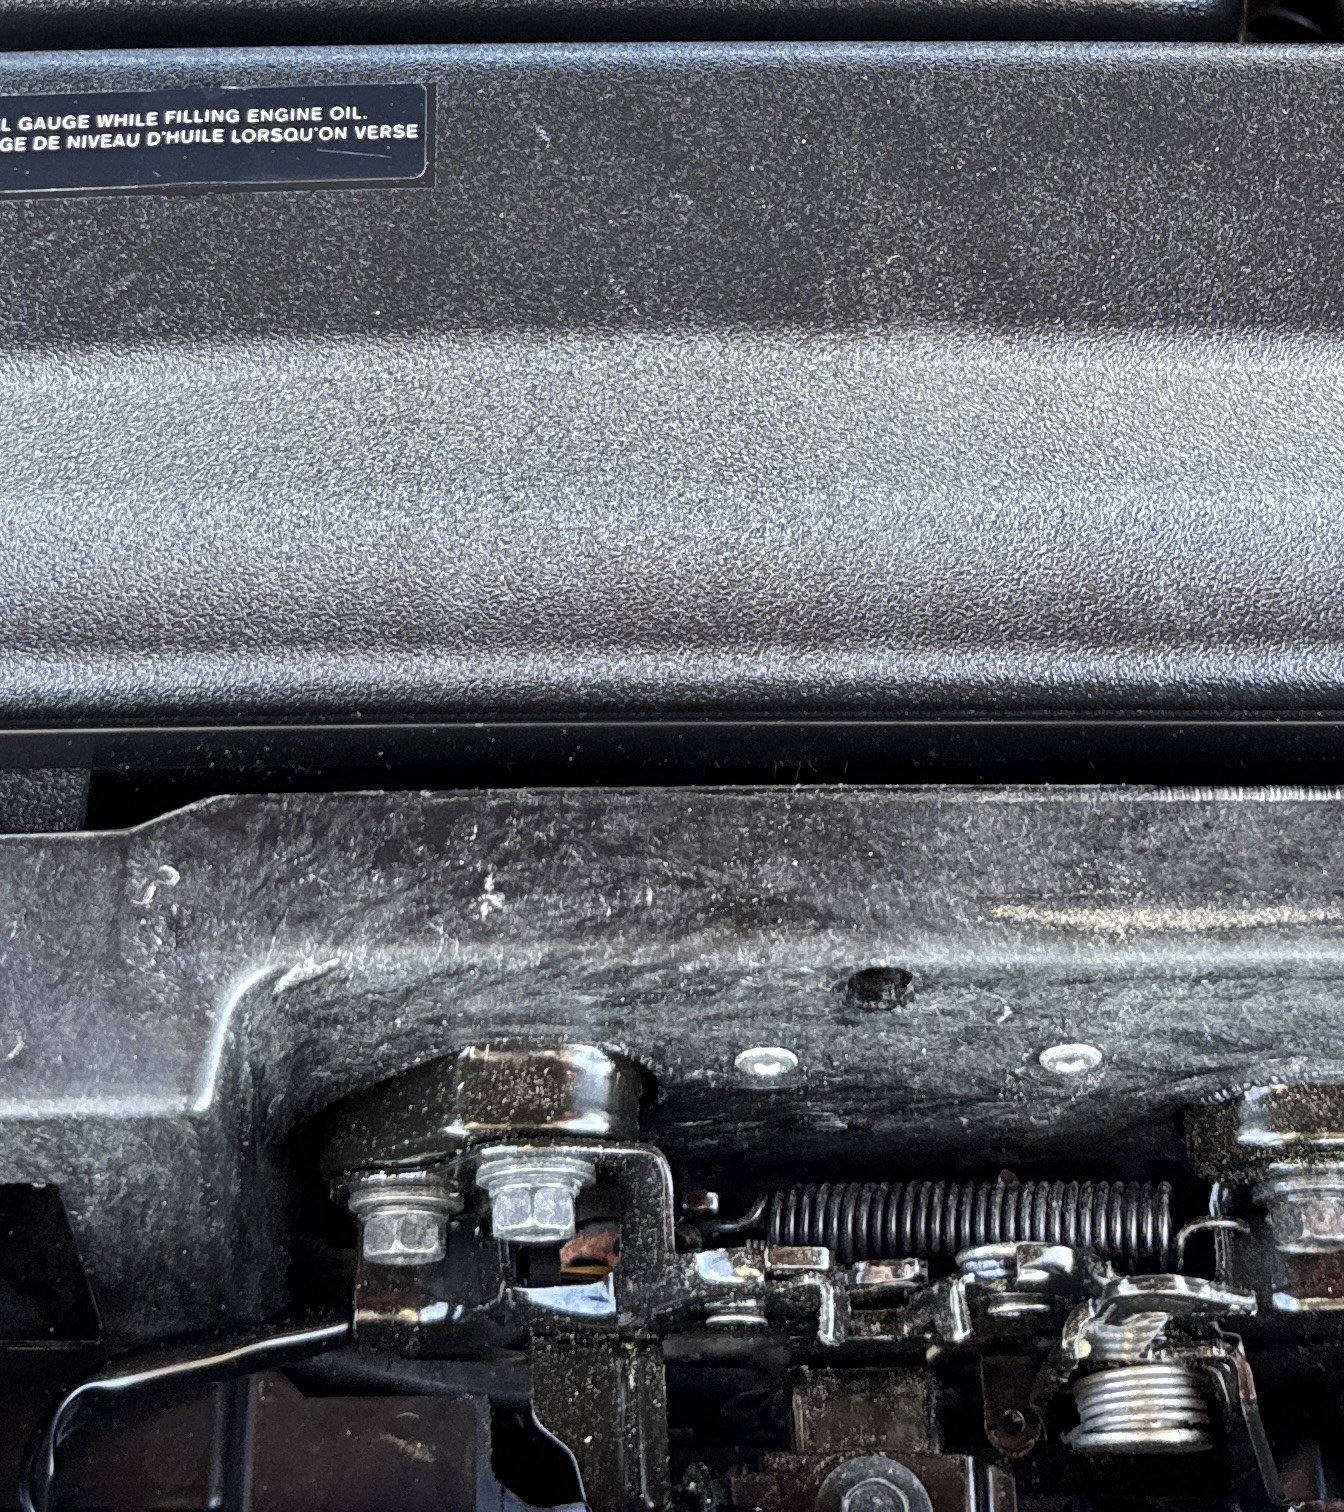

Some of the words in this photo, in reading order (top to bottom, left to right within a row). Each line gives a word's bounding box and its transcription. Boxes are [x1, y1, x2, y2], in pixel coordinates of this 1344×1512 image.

[18, 114, 89, 132] GAUGE
[96, 111, 158, 128] WHILE
[165, 108, 239, 125] FILLING
[247, 106, 323, 123] ENGINE
[329, 105, 367, 121] OIL.
[33, 135, 60, 151] DE
[67, 131, 140, 150] NIVEAU
[147, 128, 224, 147] D'HUILE
[232, 126, 347, 144] LORSQU'ON
[355, 123, 419, 140] VERSE
